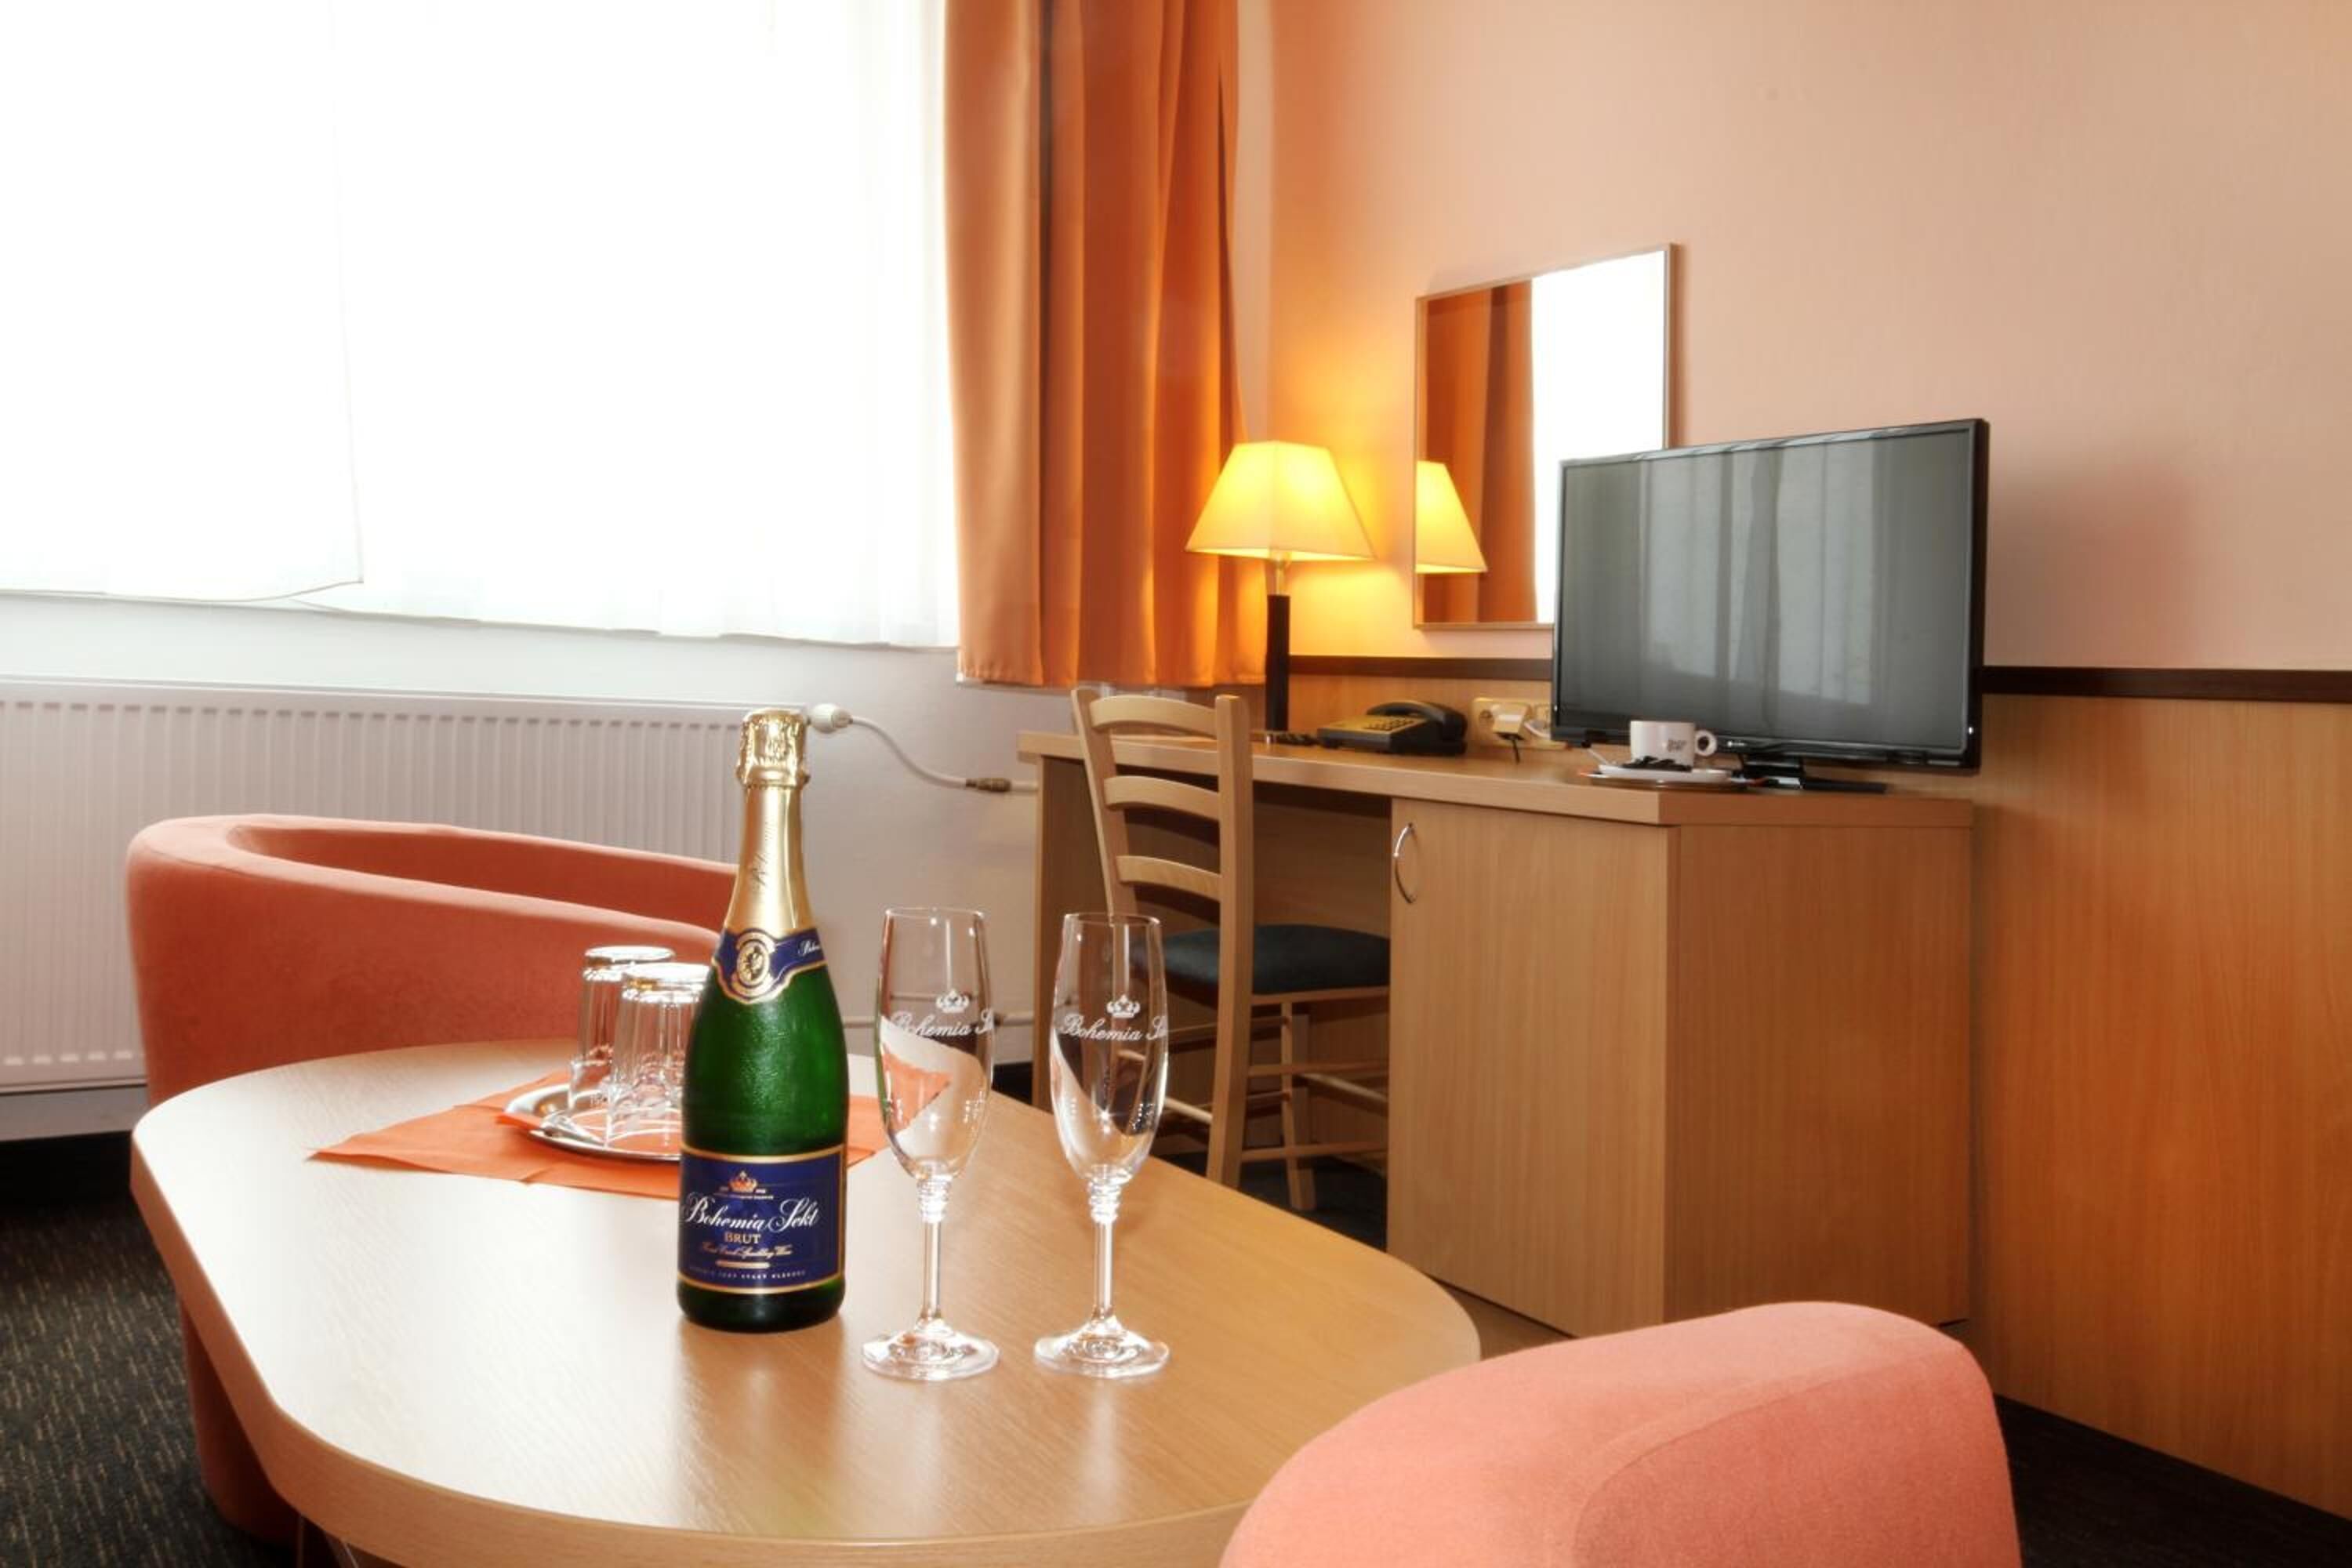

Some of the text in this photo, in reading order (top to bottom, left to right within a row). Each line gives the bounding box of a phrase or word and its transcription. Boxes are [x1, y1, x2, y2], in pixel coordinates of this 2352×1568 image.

[1058, 1013, 1142, 1041] Bohemia
[685, 1191, 818, 1233] Bohemia Sekt
[724, 1232, 761, 1244] BRUT
